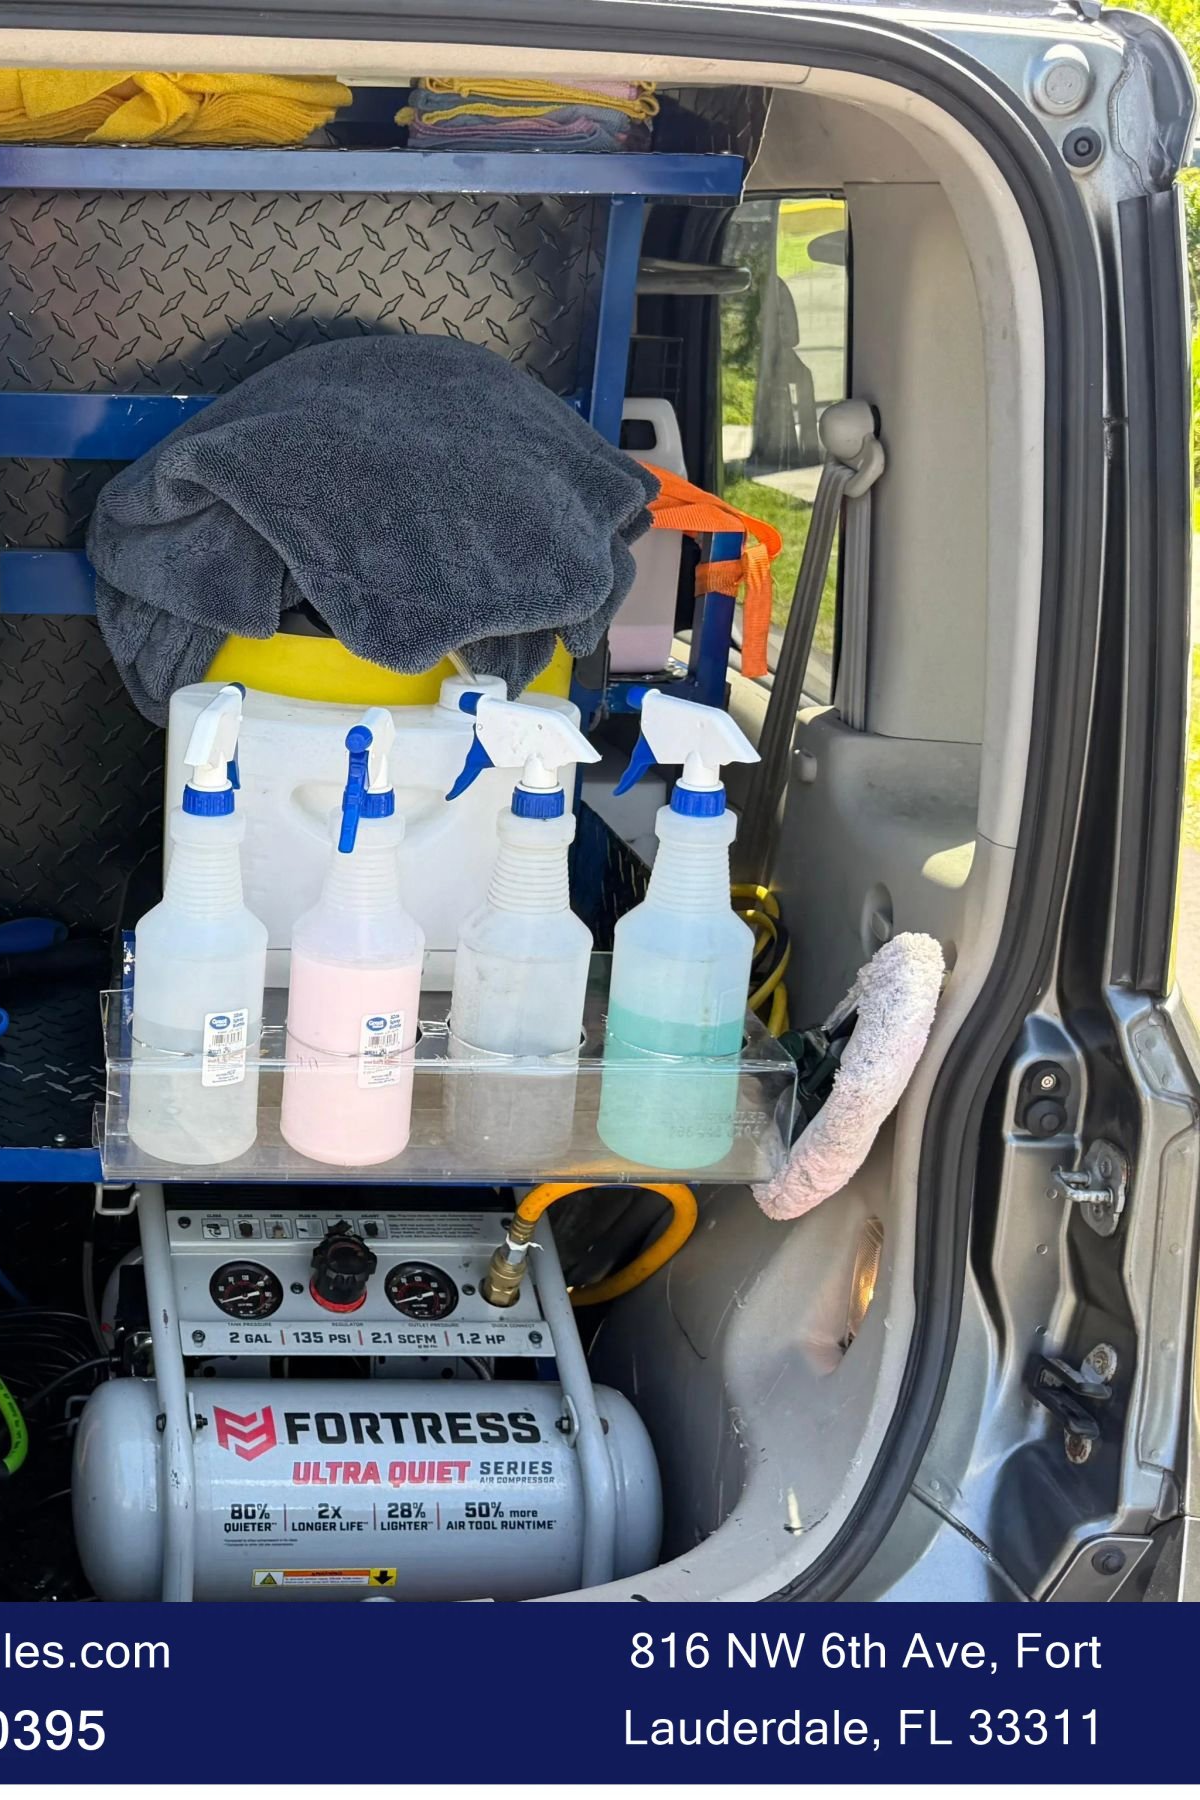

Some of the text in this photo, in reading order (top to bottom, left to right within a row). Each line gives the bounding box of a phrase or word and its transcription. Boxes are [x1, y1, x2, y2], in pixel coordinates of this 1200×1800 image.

[229, 1331, 505, 1344] 2 GAL 135 PSI 2.1 SCFM 1.2 HP
[284, 1412, 541, 1444] FORTRESS
[292, 1461, 553, 1488] ULTRA QUIET SERIES
[480, 1476, 555, 1484] AIR COMPRESSOR
[230, 1503, 270, 1520] 80%
[317, 1502, 342, 1519] 2x
[387, 1502, 426, 1519] 28%
[465, 1502, 538, 1518] 50% more
[292, 1521, 337, 1532] LONGER
[446, 1521, 466, 1530] AIR
[469, 1520, 497, 1530] TOOL
